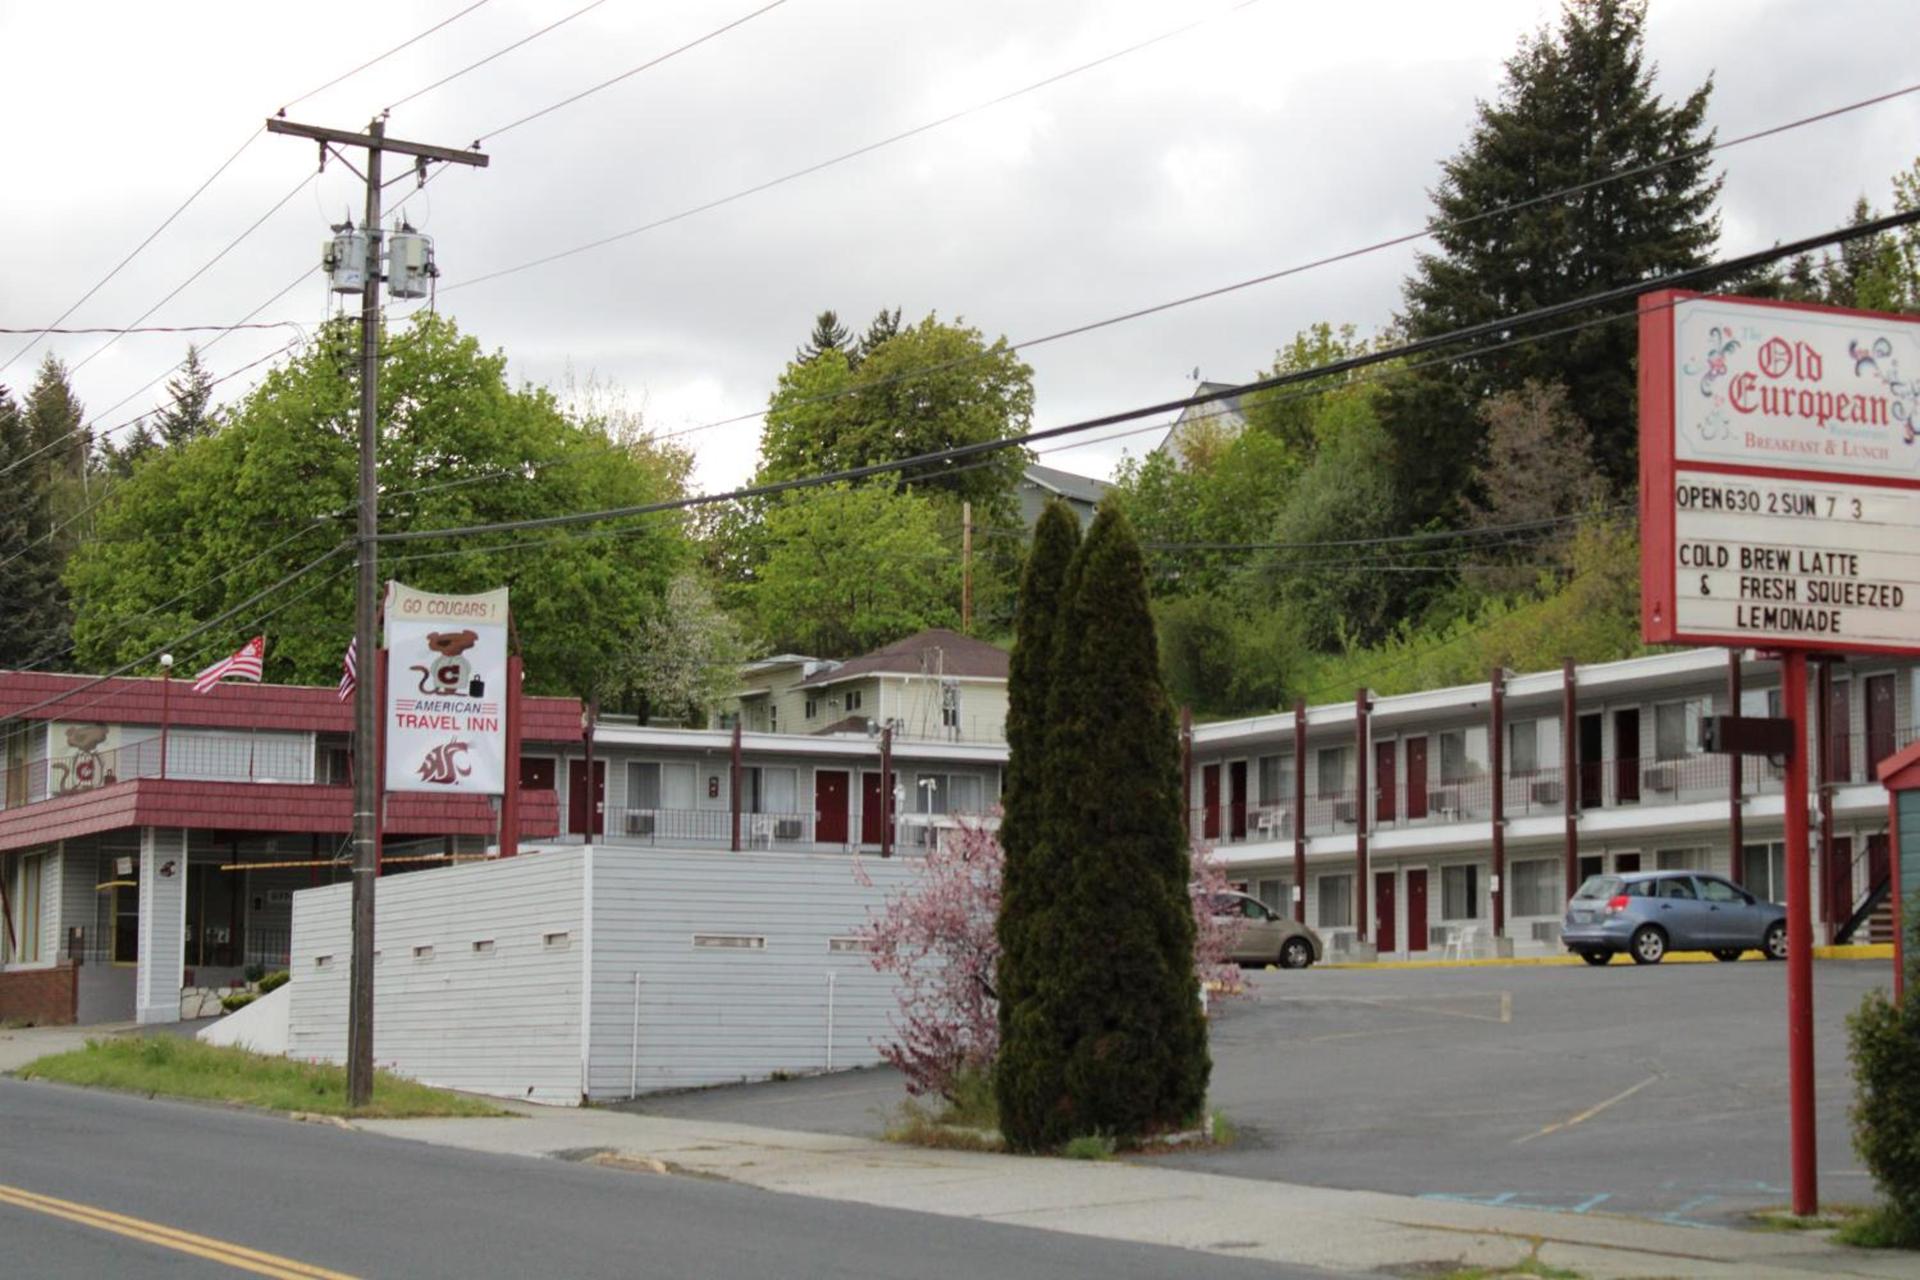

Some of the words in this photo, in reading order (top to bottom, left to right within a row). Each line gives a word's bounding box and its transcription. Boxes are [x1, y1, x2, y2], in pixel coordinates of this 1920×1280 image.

[1759, 337, 1823, 382] Old
[1729, 372, 1890, 428] European
[1745, 431, 1821, 455] BREAKFAST
[1843, 440, 1890, 461] LUNCH
[1677, 485, 1723, 510] OPEN
[1727, 488, 1760, 513] 630
[1784, 494, 1817, 517] SUN
[1826, 497, 1837, 519] 7
[1852, 499, 1863, 520] 3
[1680, 544, 1729, 570] COLD
[1741, 546, 1791, 572] BREW
[1800, 551, 1859, 577] LATTE
[404, 599, 422, 614] GO
[1700, 574, 1711, 596] &
[1741, 576, 1797, 602] FRESH
[1808, 580, 1904, 609] SQUEEZED
[1738, 605, 1842, 634] LEMONADE
[397, 714, 460, 731] TRAVEL
[468, 718, 499, 732] INN
[416, 701, 482, 714] AMERICAN
